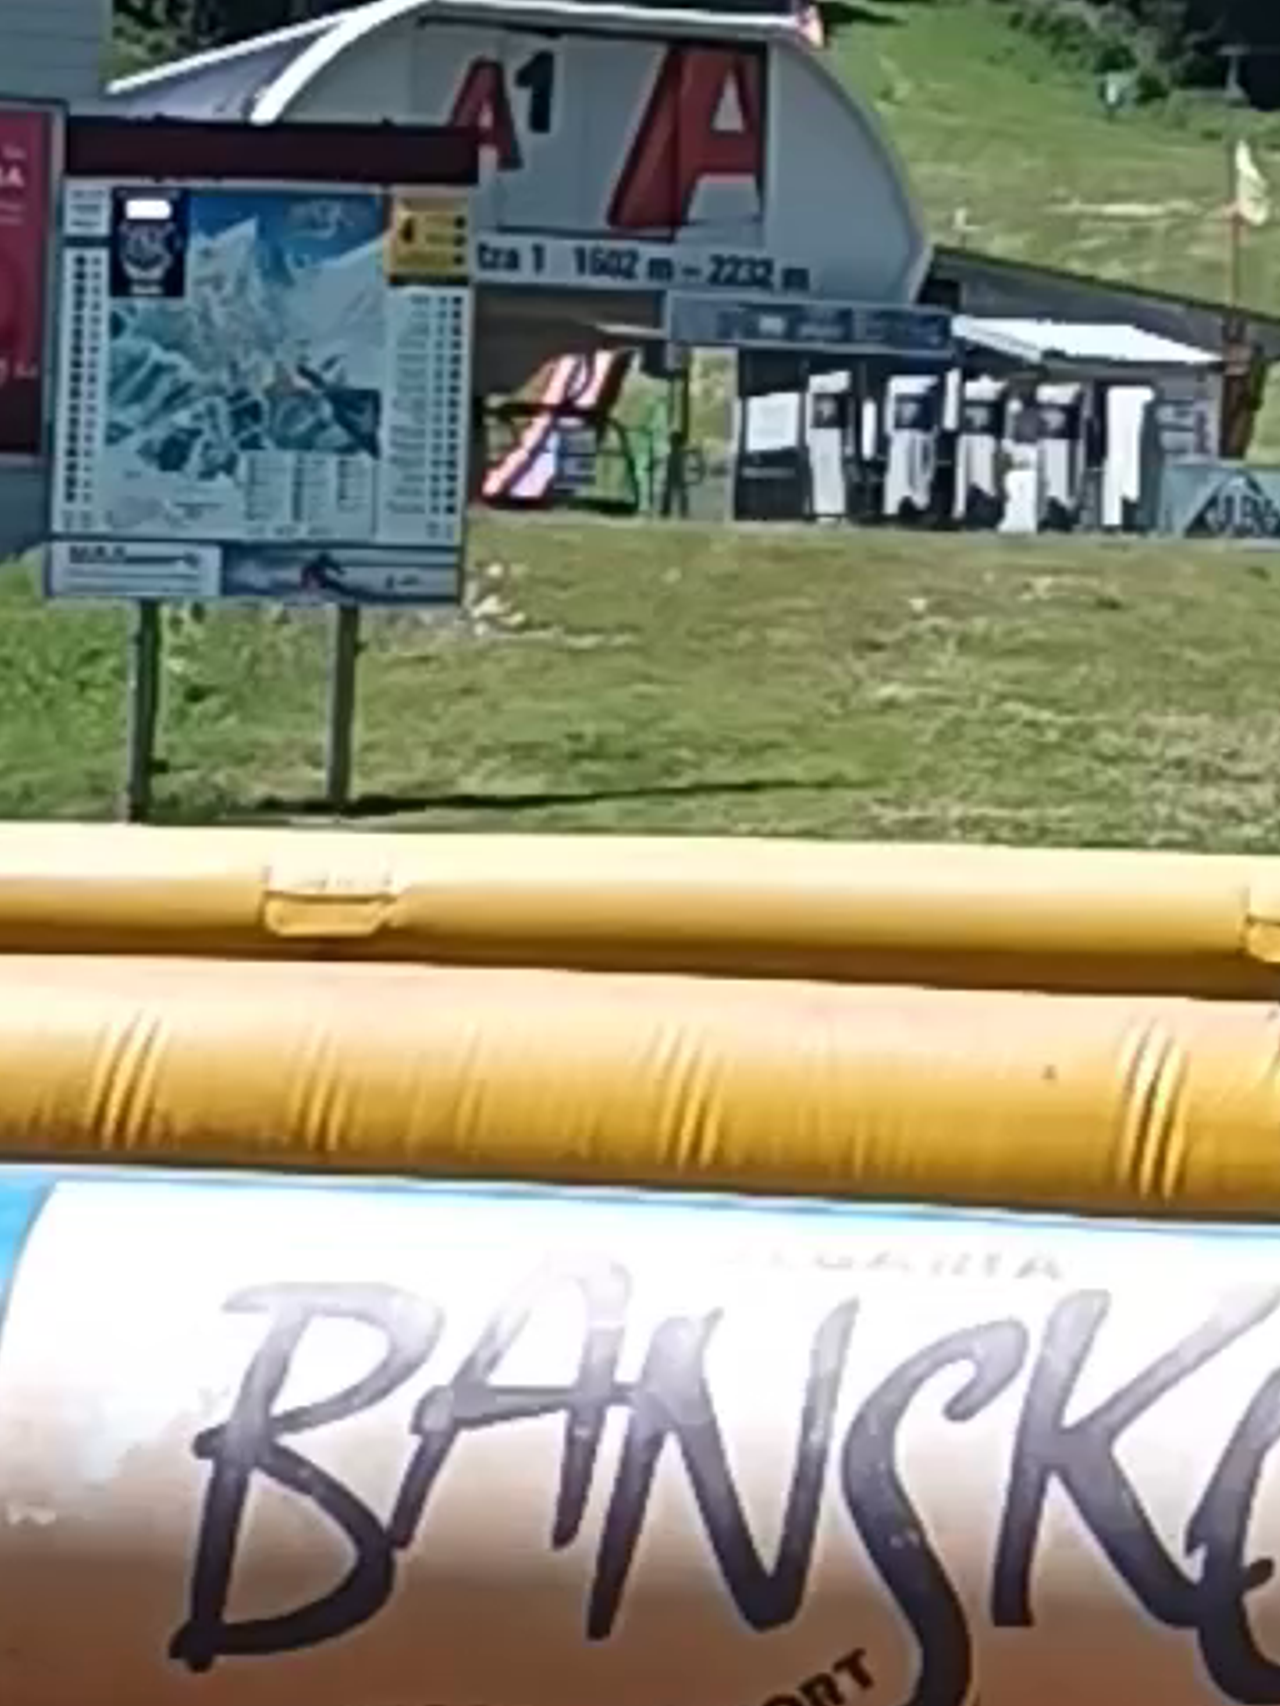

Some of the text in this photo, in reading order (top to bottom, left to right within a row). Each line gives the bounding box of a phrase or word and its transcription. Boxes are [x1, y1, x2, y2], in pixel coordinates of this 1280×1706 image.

[531, 242, 547, 275] 1
[647, 256, 675, 281] m
[708, 253, 775, 290] 2232
[781, 266, 811, 290] m
